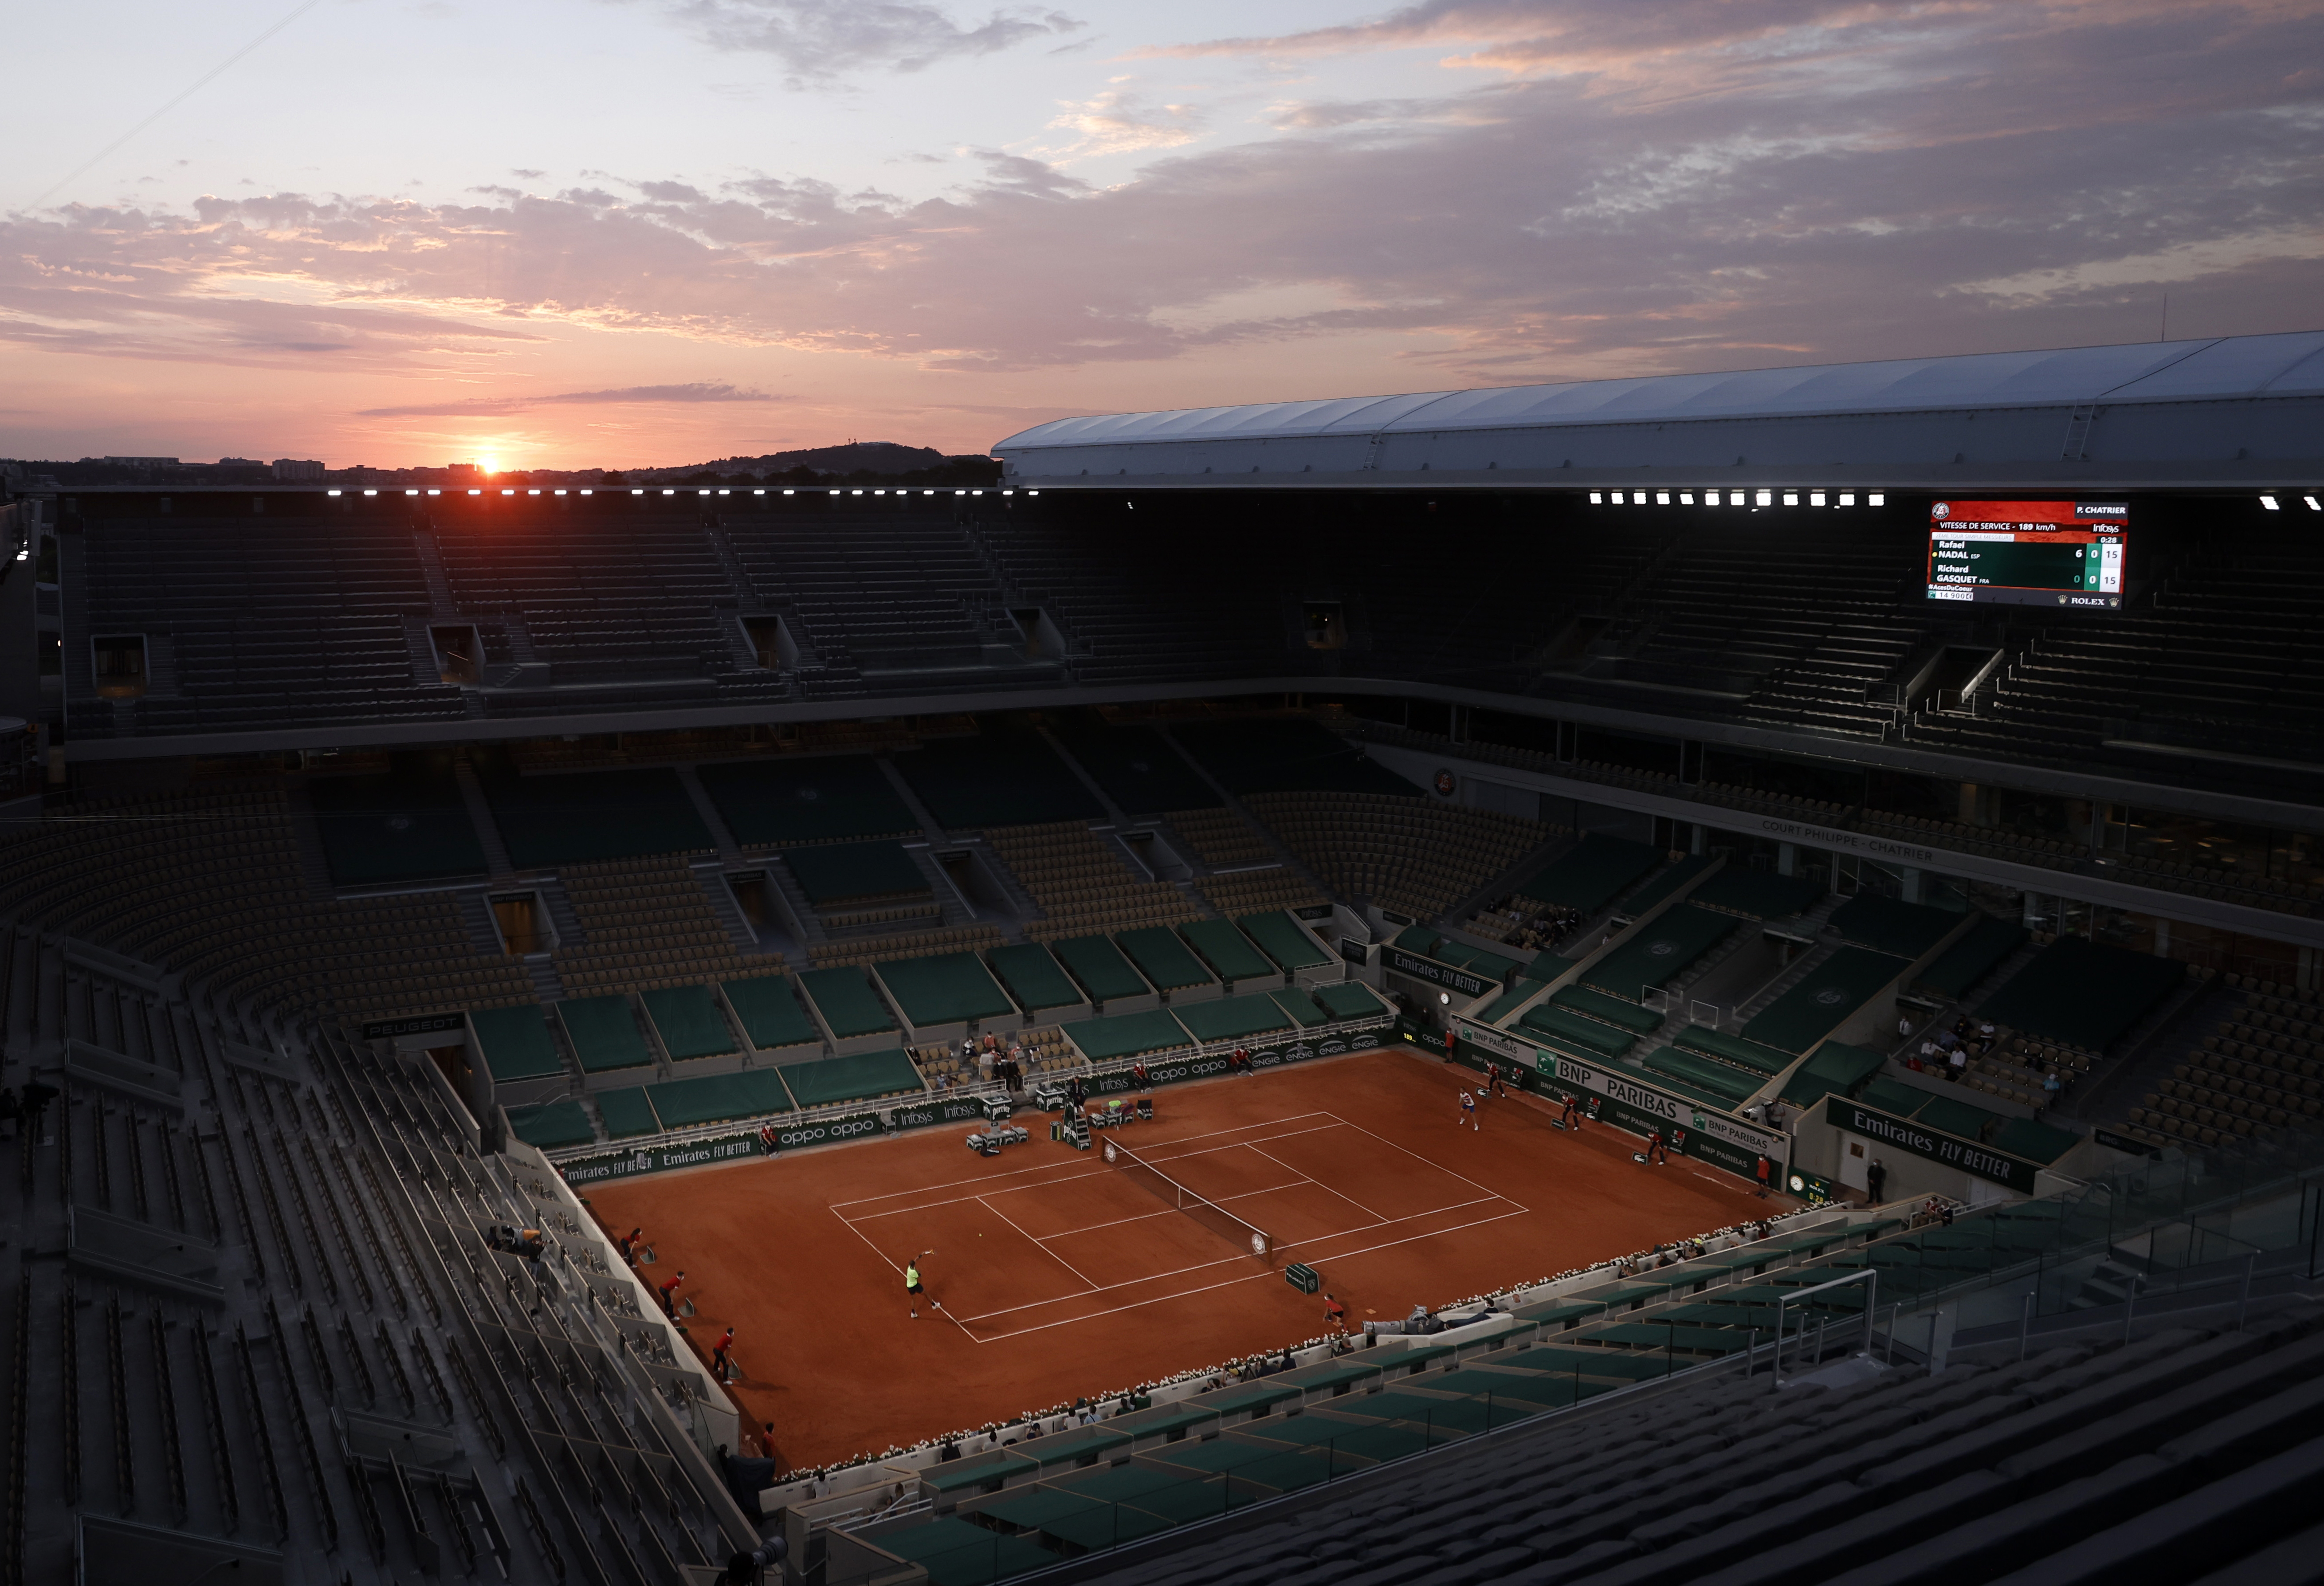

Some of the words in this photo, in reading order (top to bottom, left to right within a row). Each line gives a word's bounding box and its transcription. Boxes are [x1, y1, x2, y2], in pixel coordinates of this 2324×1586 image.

[2093, 524, 2120, 534] Infosys
[2075, 549, 2083, 558] 6
[2091, 550, 2098, 558] 0
[1937, 565, 1969, 573] Richard
[1936, 574, 1978, 584] GASQUET
[2073, 575, 2081, 583] 0
[2089, 576, 2096, 584] 0
[1763, 820, 1802, 835] COURT
[1805, 828, 1858, 847] PHILIPPE
[1869, 841, 1932, 861] CHATRIER
[1302, 909, 1323, 918] Infosys
[1395, 953, 1439, 979] Emirates
[1442, 970, 1455, 984] FLY
[1455, 974, 1480, 993] BETTER
[370, 1018, 456, 1036] PEUGEOT
[1422, 1034, 1445, 1047] oppo
[1474, 1032, 1488, 1042] BNP
[1489, 1037, 1517, 1054] PARIBAS
[1472, 1054, 1483, 1063] BNP
[1151, 1066, 1187, 1082] oppo
[1192, 1060, 1226, 1075] oppo
[1099, 1077, 1128, 1091] Infosys
[1540, 1081, 1553, 1090] BNP
[1560, 1061, 1591, 1084] BNP
[1607, 1079, 1676, 1118] PARIBAS
[901, 1111, 933, 1126] Infosys
[944, 1104, 976, 1119] Infosys
[831, 1120, 874, 1137] oppo
[1617, 1111, 1630, 1120] BNP
[1631, 1117, 1659, 1133] PARIBAS
[781, 1128, 825, 1145] oppo
[1709, 1120, 1727, 1132] BNP
[1730, 1128, 1767, 1149] PARIBAS
[1854, 1110, 1933, 1152] Emirates
[1940, 1141, 1962, 1161] FLY
[1963, 1150, 2010, 1179] BETTER
[663, 1149, 710, 1166] Emirates
[714, 1146, 726, 1158] FLY
[726, 1141, 751, 1155] BETTER
[1700, 1144, 1716, 1154] BNP
[1716, 1150, 1748, 1168] PARIBAS
[563, 1166, 609, 1182] Emirates
[614, 1163, 625, 1174] FLY
[1809, 1184, 1825, 1194] ROLEX
[1286, 1272, 1304, 1286] PEUGEOT
